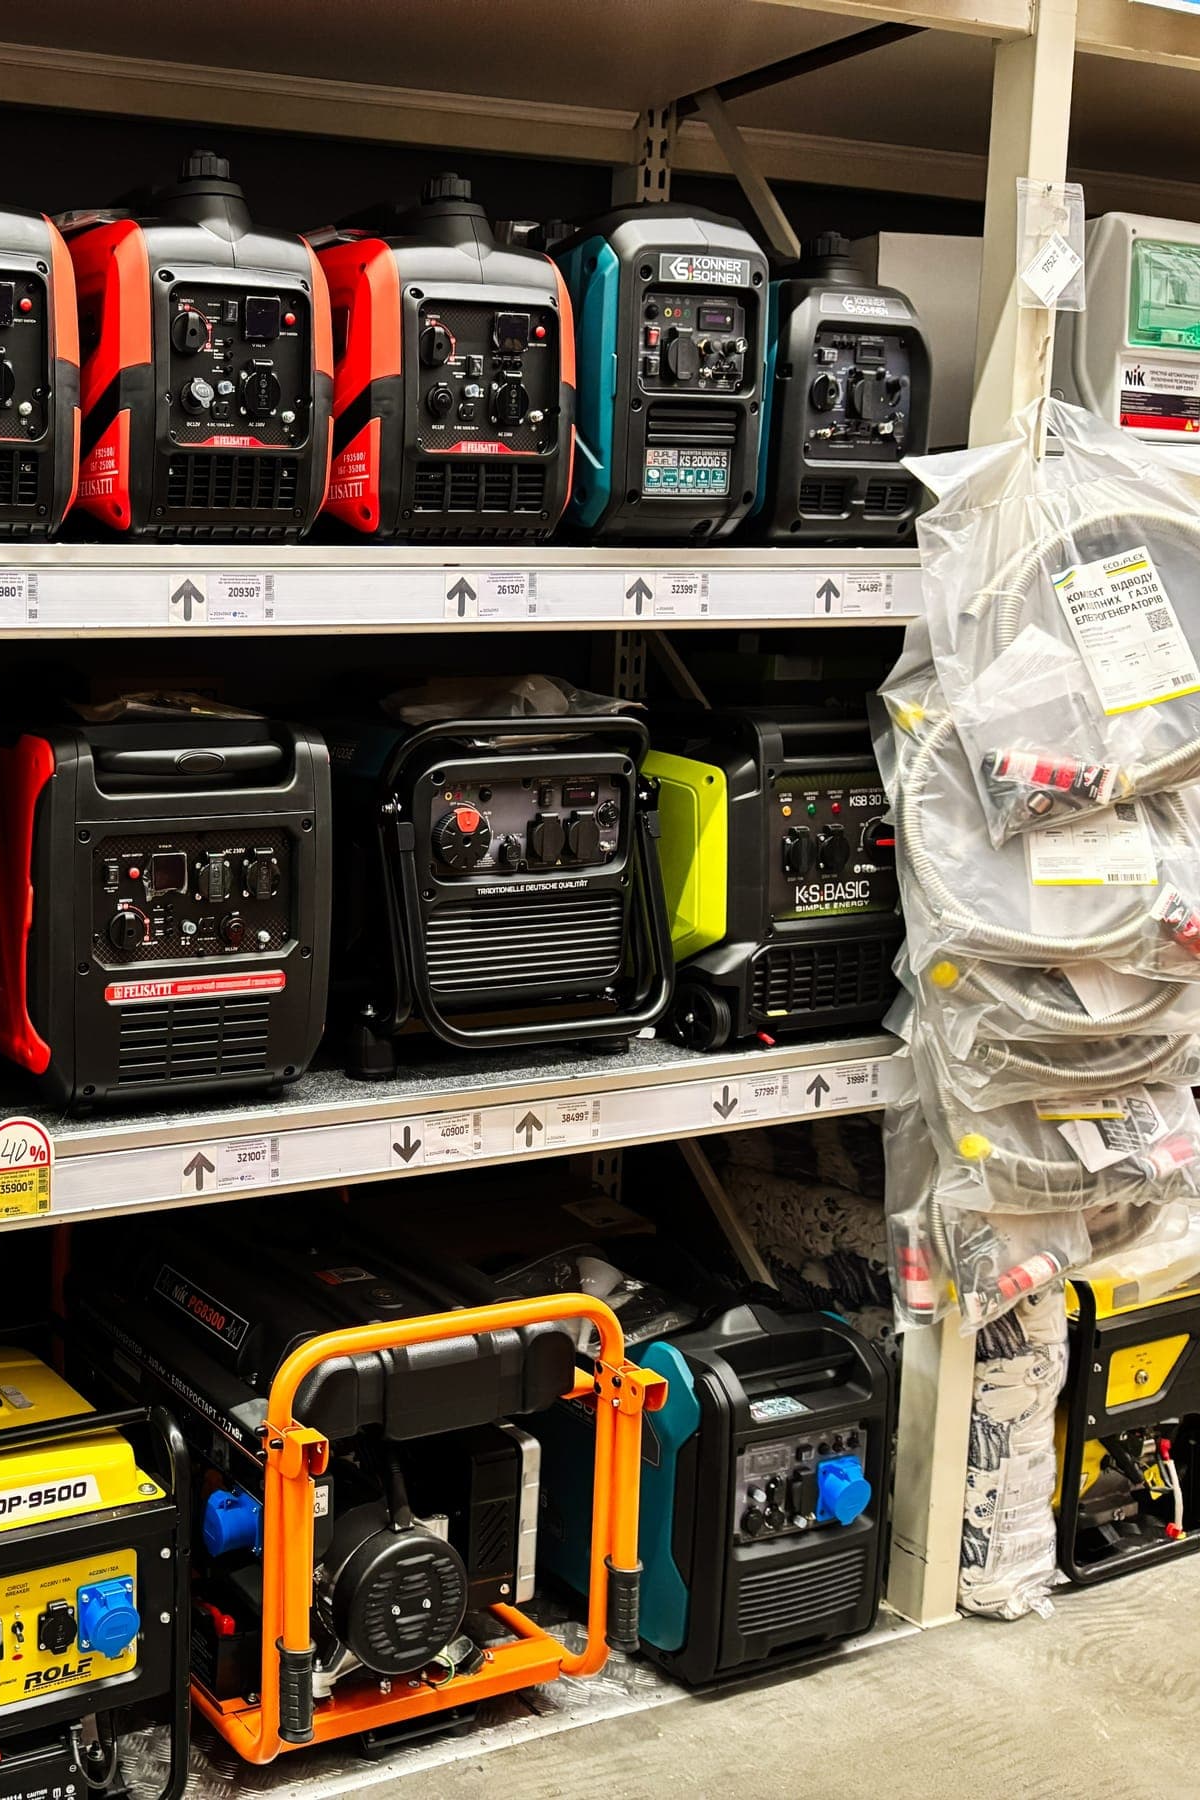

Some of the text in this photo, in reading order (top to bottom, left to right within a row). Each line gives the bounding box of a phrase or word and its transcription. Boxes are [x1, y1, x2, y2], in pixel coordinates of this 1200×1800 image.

[693, 257, 742, 272] KONNER
[693, 270, 741, 284] SOHNEN
[220, 436, 250, 446] FELISATTI
[467, 443, 499, 454] FELISATTI
[679, 455, 690, 467] KS
[1110, 571, 1154, 593] ВІДВОДУ
[227, 587, 255, 598] 20930
[496, 584, 520, 595] 26130
[670, 584, 694, 594] 32399
[1128, 583, 1159, 600] ГАЗІВ
[849, 795, 868, 807] KSB
[477, 885, 525, 895] TRADITIONELLE
[525, 882, 558, 892] DEUTSCHE
[823, 880, 870, 902] BASIC
[795, 899, 870, 913] SIMPLE ENERGY
[123, 983, 173, 999] FELISATTI
[561, 1112, 584, 1124] 38499
[440, 1127, 465, 1138] 40900
[237, 1151, 261, 1163] 32100
[0, 1181, 28, 1195] 35900
[187, 1295, 226, 1331] PG8300
[171, 1373, 217, 1420] ЕЛЕКТРОСТАРТ
[4, 1587, 31, 1598] BREAKER
[6, 1582, 29, 1592] CIRCUIT
[24, 1657, 93, 1691] ROLF
[26, 1788, 48, 1799] CAUTION
